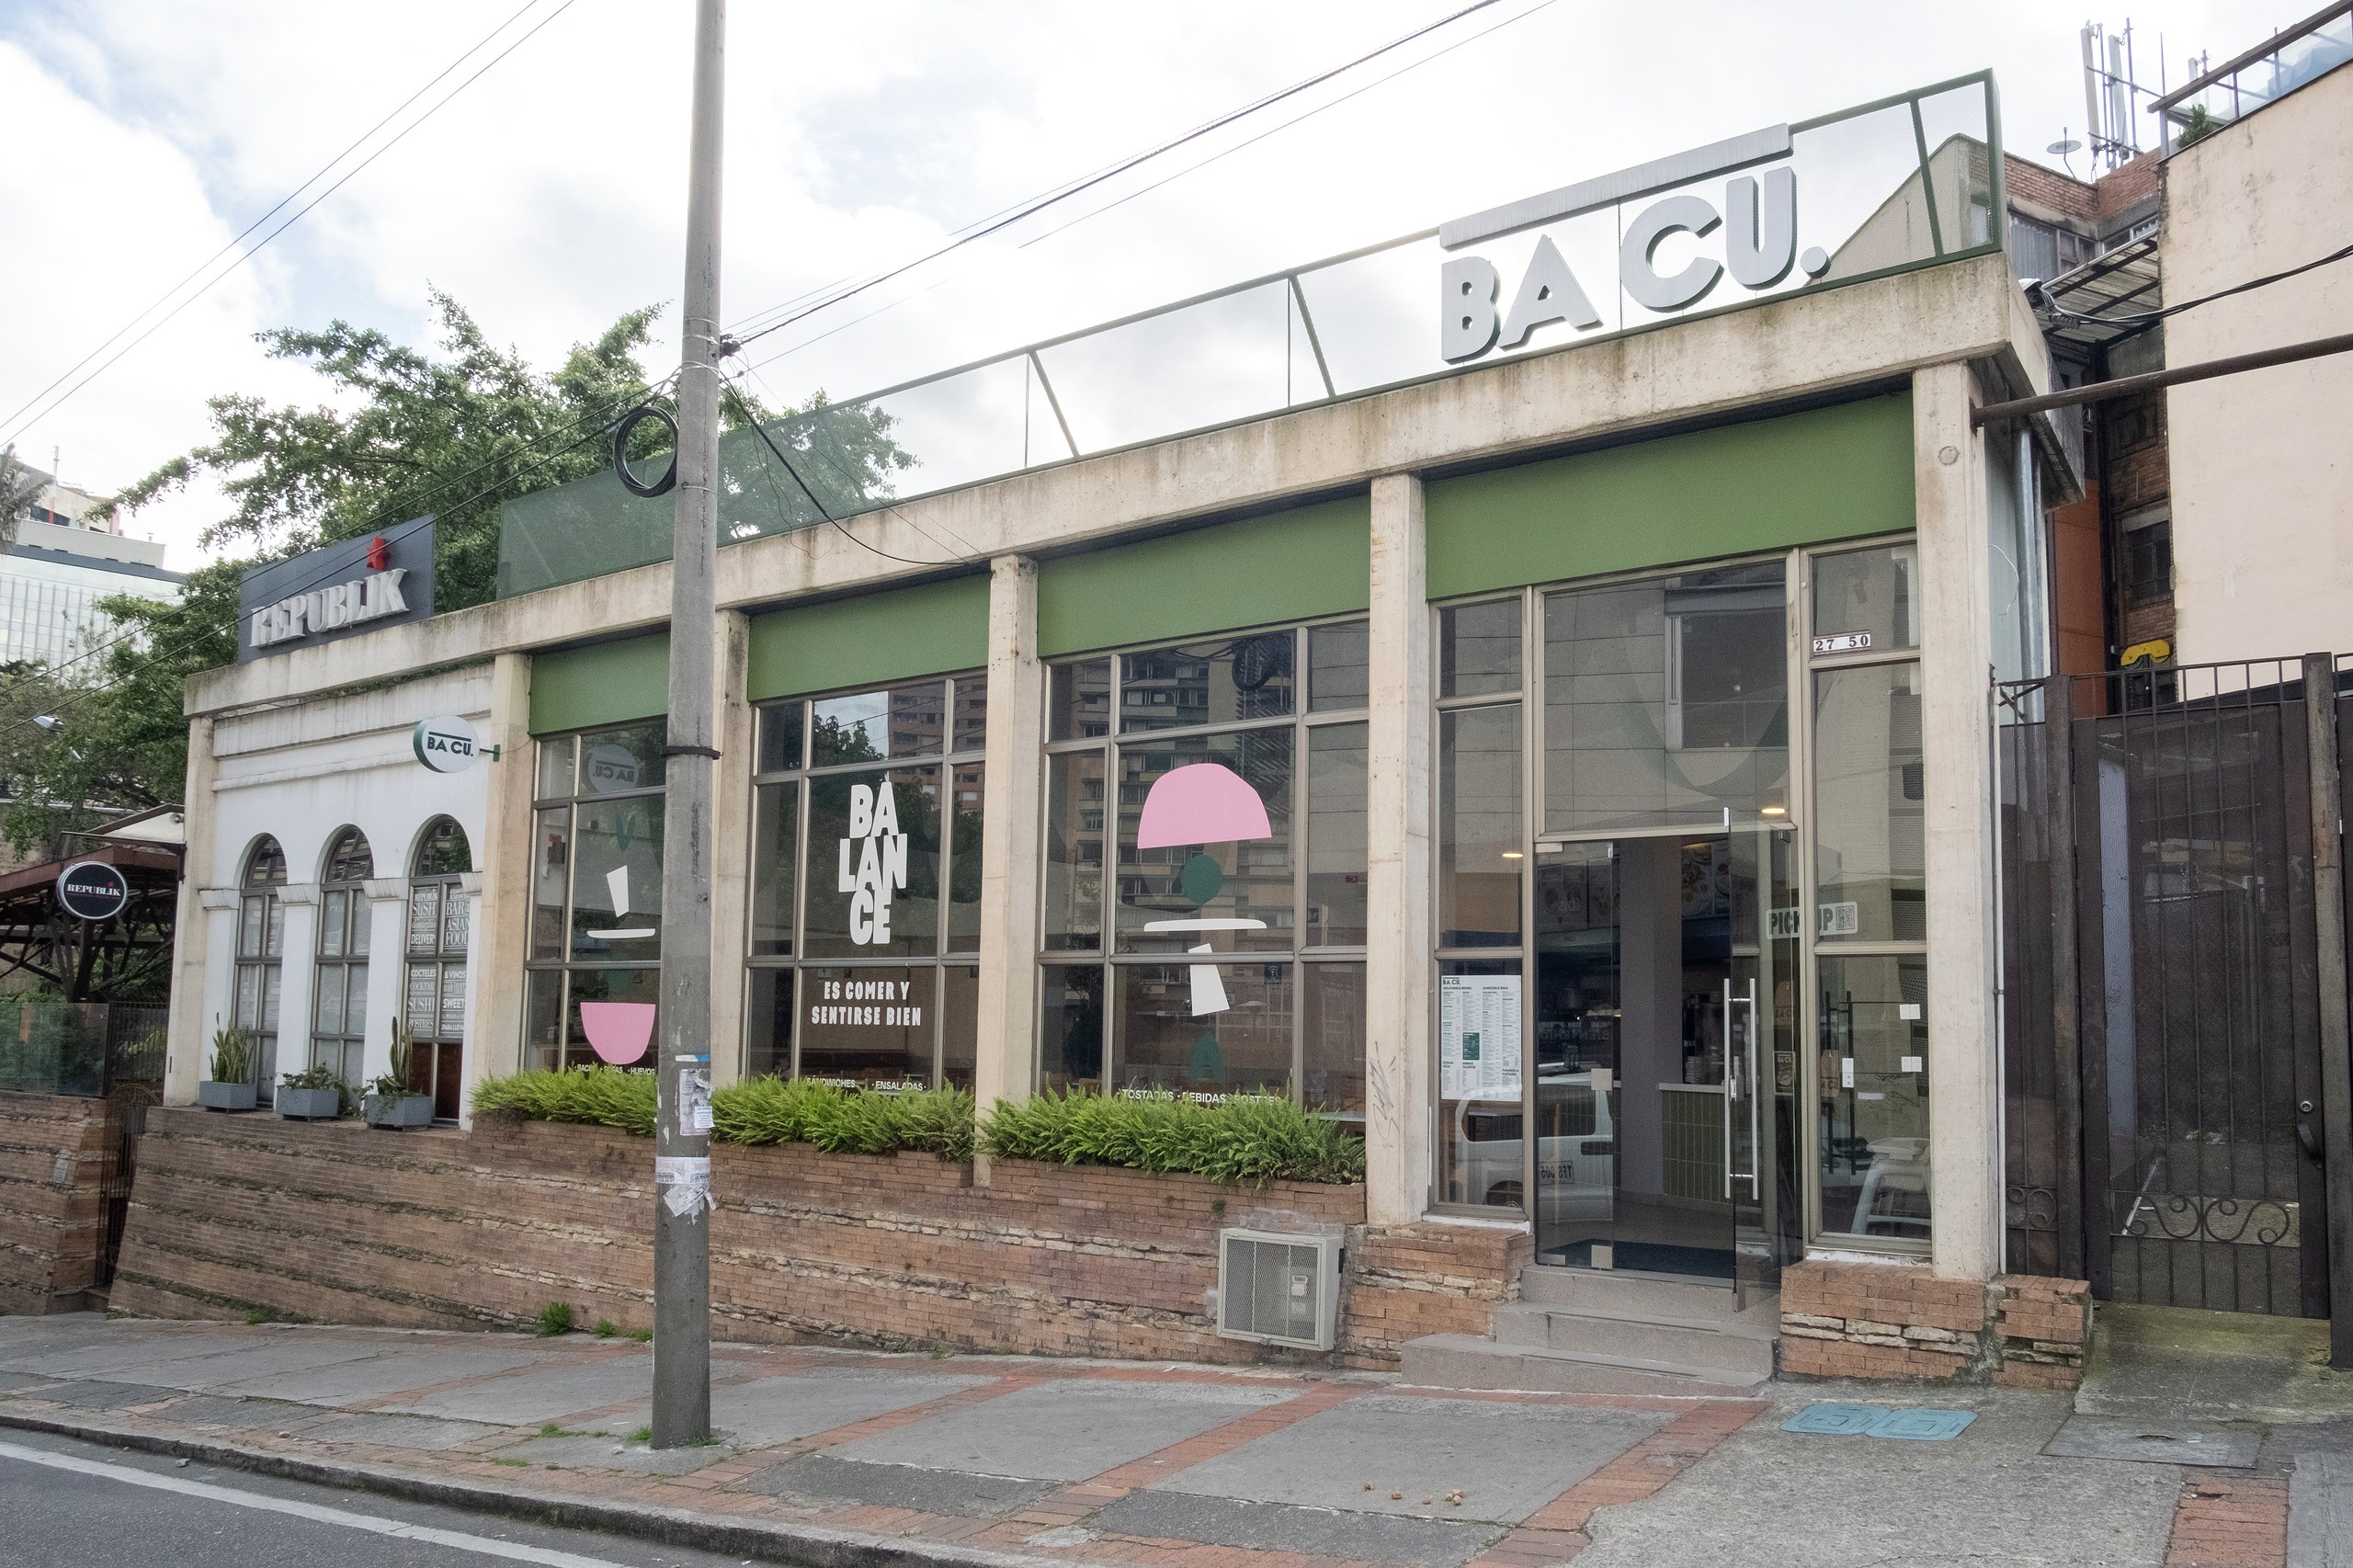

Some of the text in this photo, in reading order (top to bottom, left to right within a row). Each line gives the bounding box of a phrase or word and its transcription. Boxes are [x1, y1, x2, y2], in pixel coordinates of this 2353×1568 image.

[1440, 233, 1603, 364] BA
[249, 568, 410, 647] REPUBLIK
[1815, 635, 1869, 651] 27 50
[427, 736, 448, 753] BA
[849, 781, 899, 839] BA
[838, 833, 908, 892] LAN
[67, 883, 121, 897] REPUBLIK
[446, 901, 464, 915] BAR
[849, 888, 892, 946] CE
[410, 969, 437, 978] COCTELES
[824, 981, 910, 1000] ES COMER Y
[408, 997, 435, 1012] SUSHI
[811, 1006, 921, 1026] SENTIRSE BIEN
